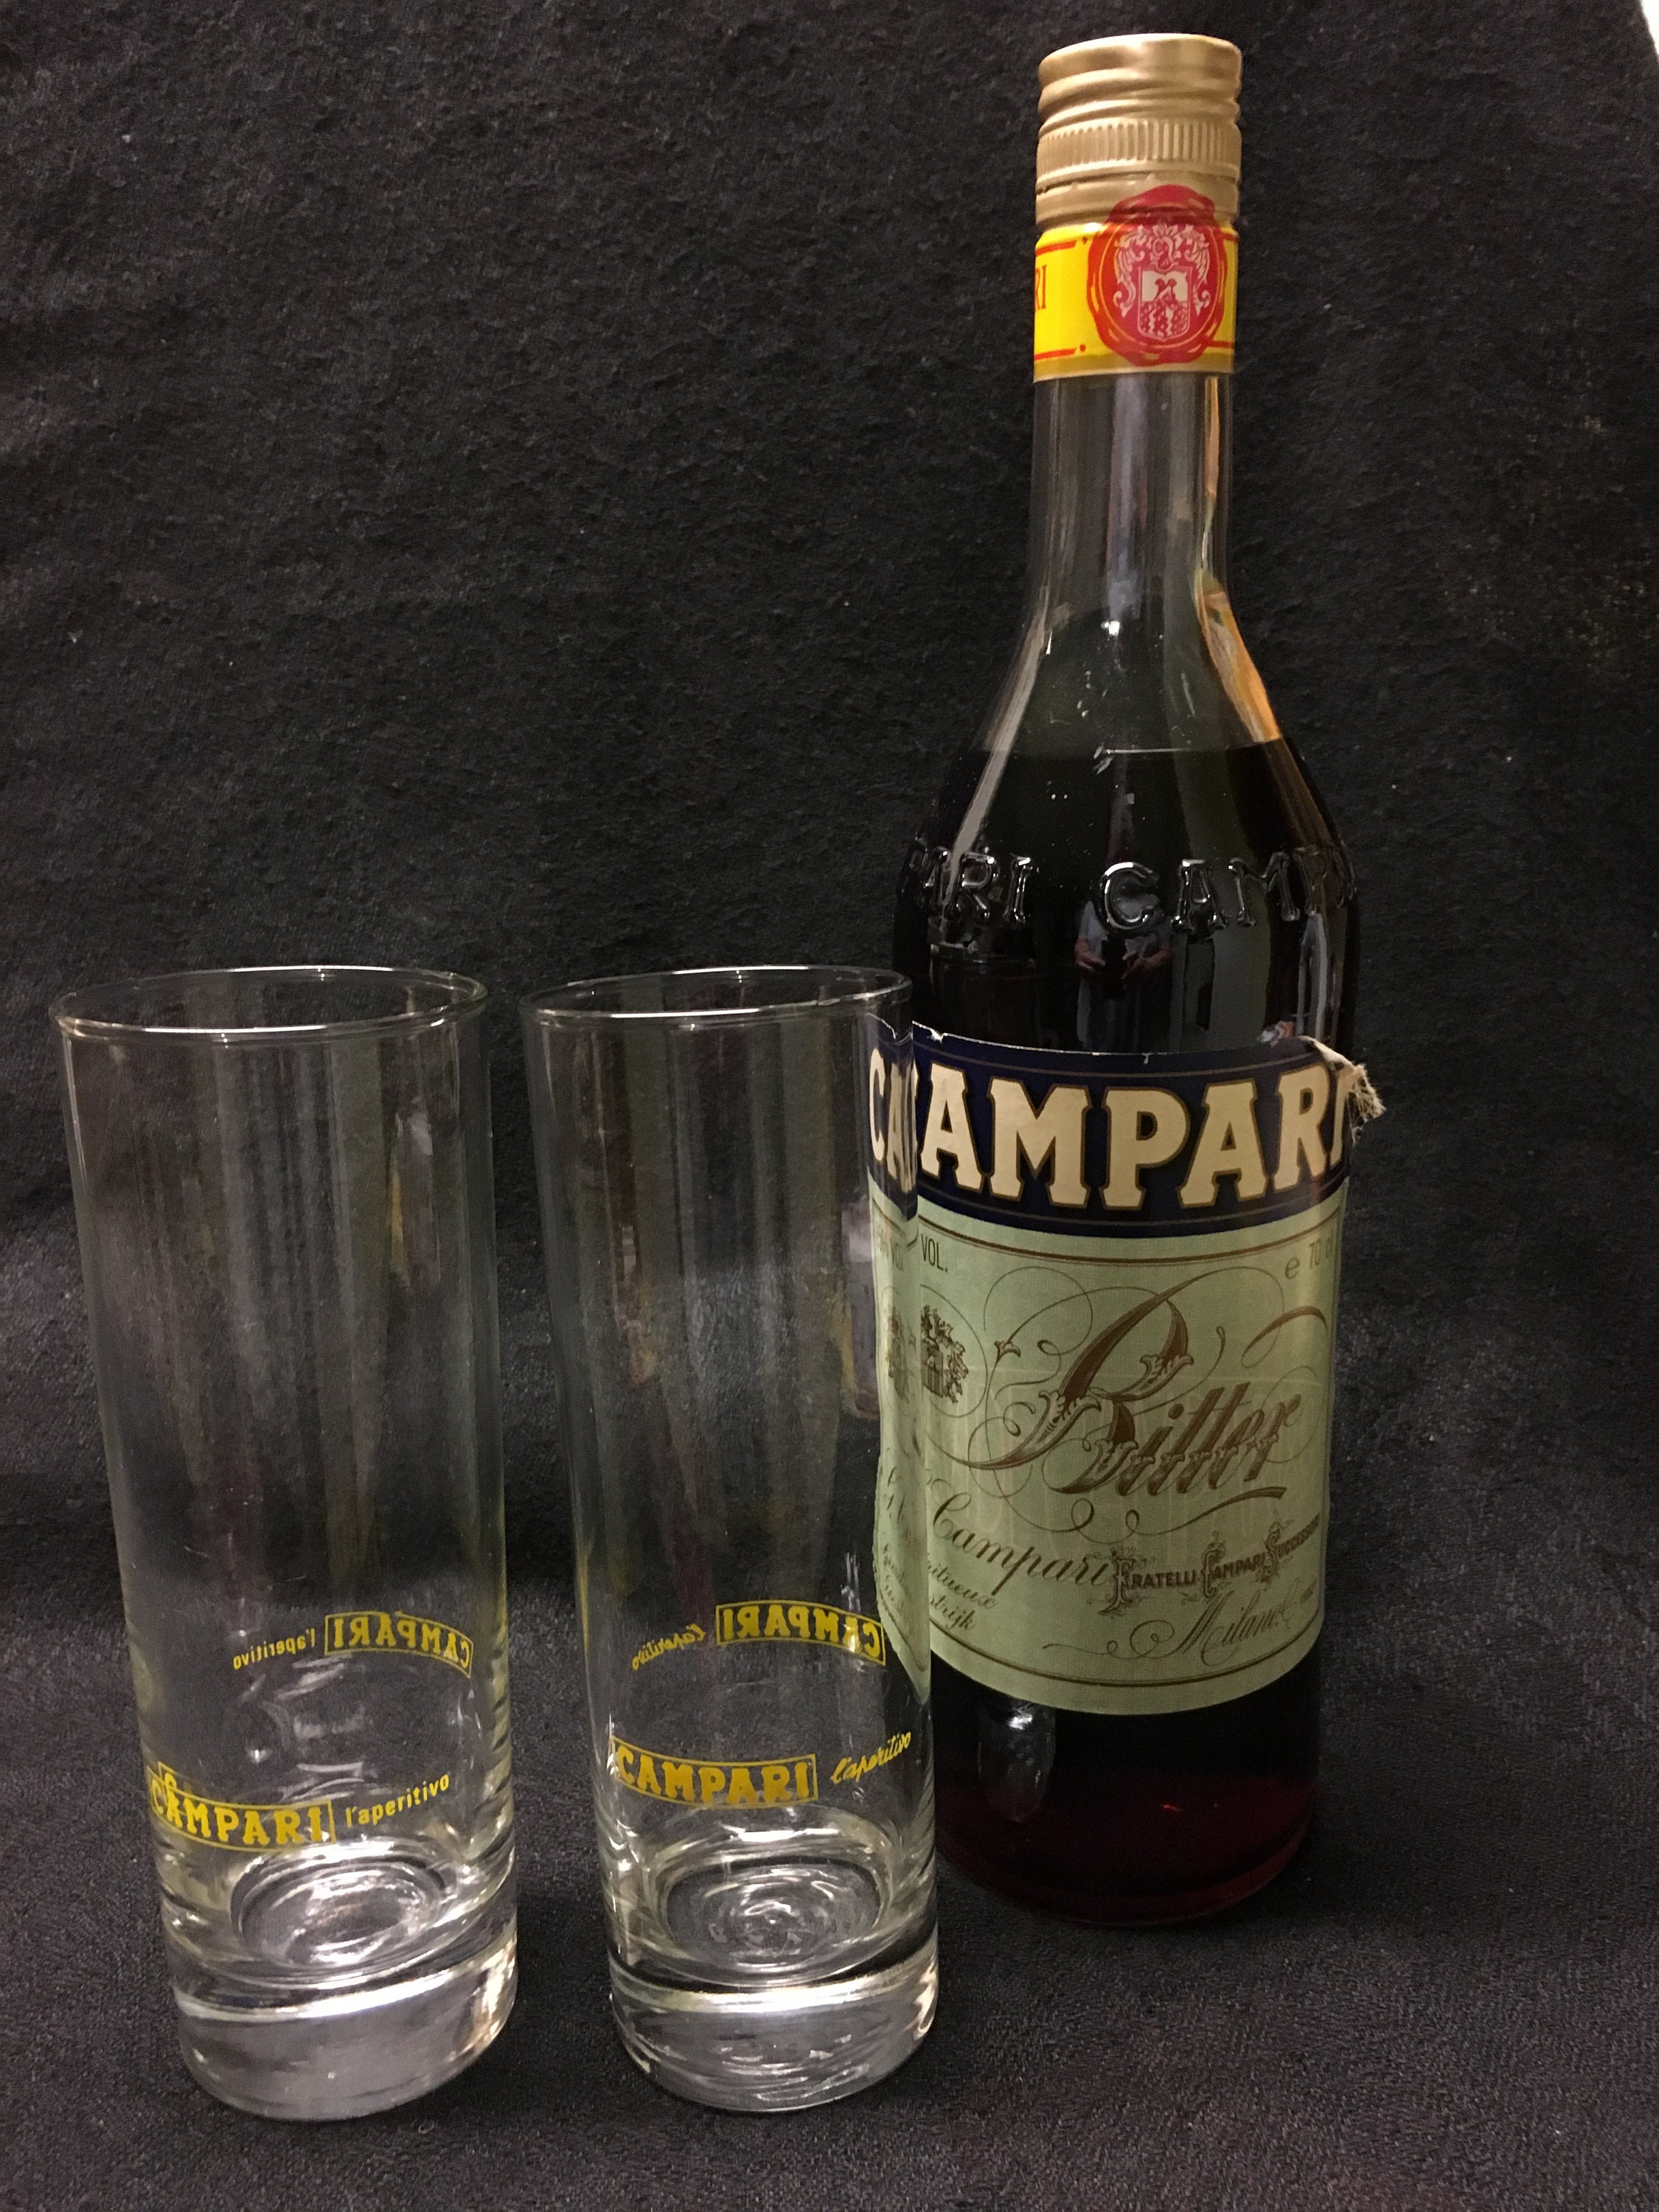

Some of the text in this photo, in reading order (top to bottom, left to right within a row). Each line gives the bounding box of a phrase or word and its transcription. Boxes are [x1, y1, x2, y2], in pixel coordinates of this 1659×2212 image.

[920, 1233, 948, 1273] VOL.
[966, 1283, 1305, 1504] Bitter
[931, 1482, 1108, 1596] Campari
[151, 1773, 451, 1846] CAMPARI l'aperitivo
[617, 1745, 809, 1804] CAMPARI
